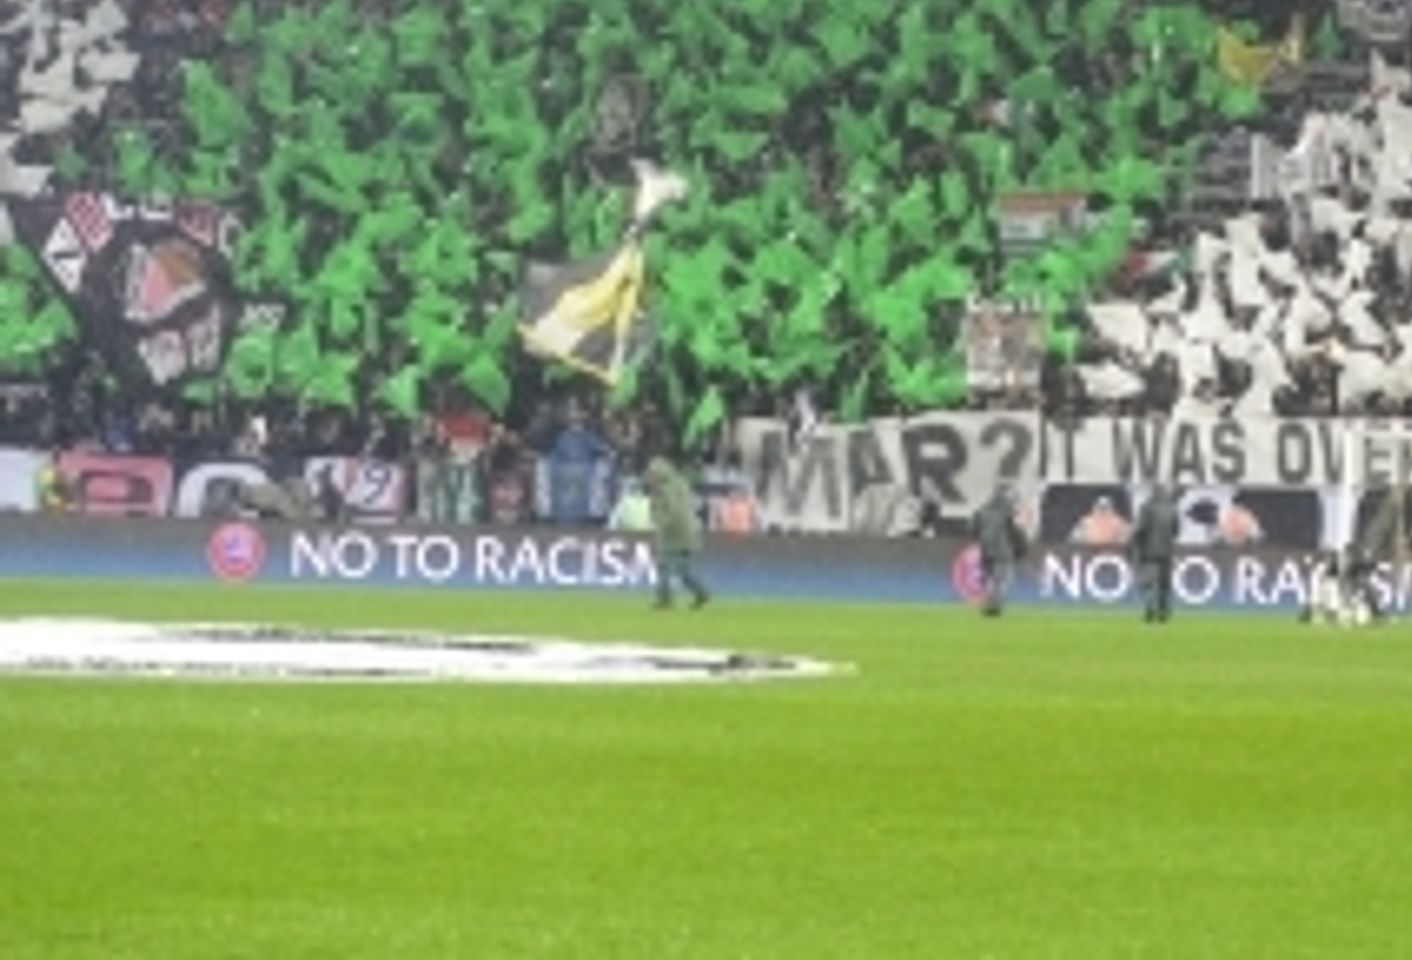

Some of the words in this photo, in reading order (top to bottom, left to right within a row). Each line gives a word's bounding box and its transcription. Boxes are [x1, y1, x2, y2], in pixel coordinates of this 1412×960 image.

[1112, 419, 1246, 483] WAS
[290, 531, 378, 578] NO
[390, 534, 461, 581] TO
[475, 535, 657, 584] RACISM
[1042, 552, 1132, 602] NO
